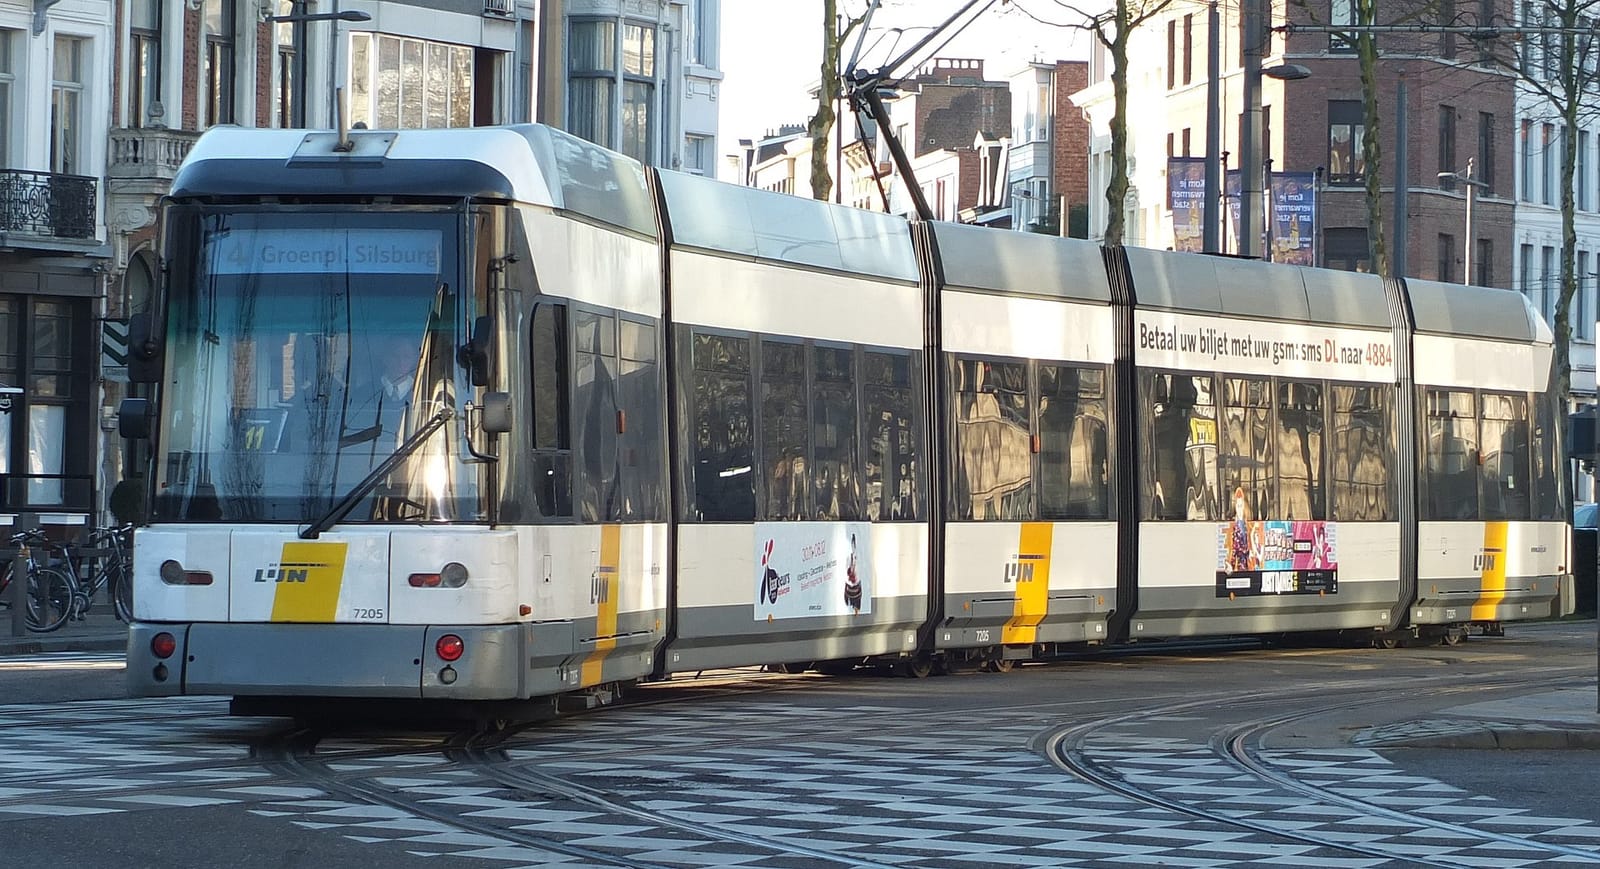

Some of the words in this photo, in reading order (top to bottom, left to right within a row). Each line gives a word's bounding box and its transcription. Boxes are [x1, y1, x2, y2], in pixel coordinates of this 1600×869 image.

[261, 245, 348, 267] Groenpl.
[355, 245, 438, 267] Silsburg
[1140, 323, 1177, 351] Betaal
[1180, 333, 1197, 353] uw
[1199, 327, 1228, 361] biljet
[1231, 334, 1252, 357] met
[1254, 340, 1270, 359] uw
[1272, 341, 1299, 365] gsm:
[1301, 343, 1322, 362] sms
[1324, 339, 1339, 363] DL
[1341, 346, 1363, 365] naar
[1365, 342, 1393, 367] 4884
[353, 608, 384, 619] 7205
[975, 630, 990, 642] 7205
